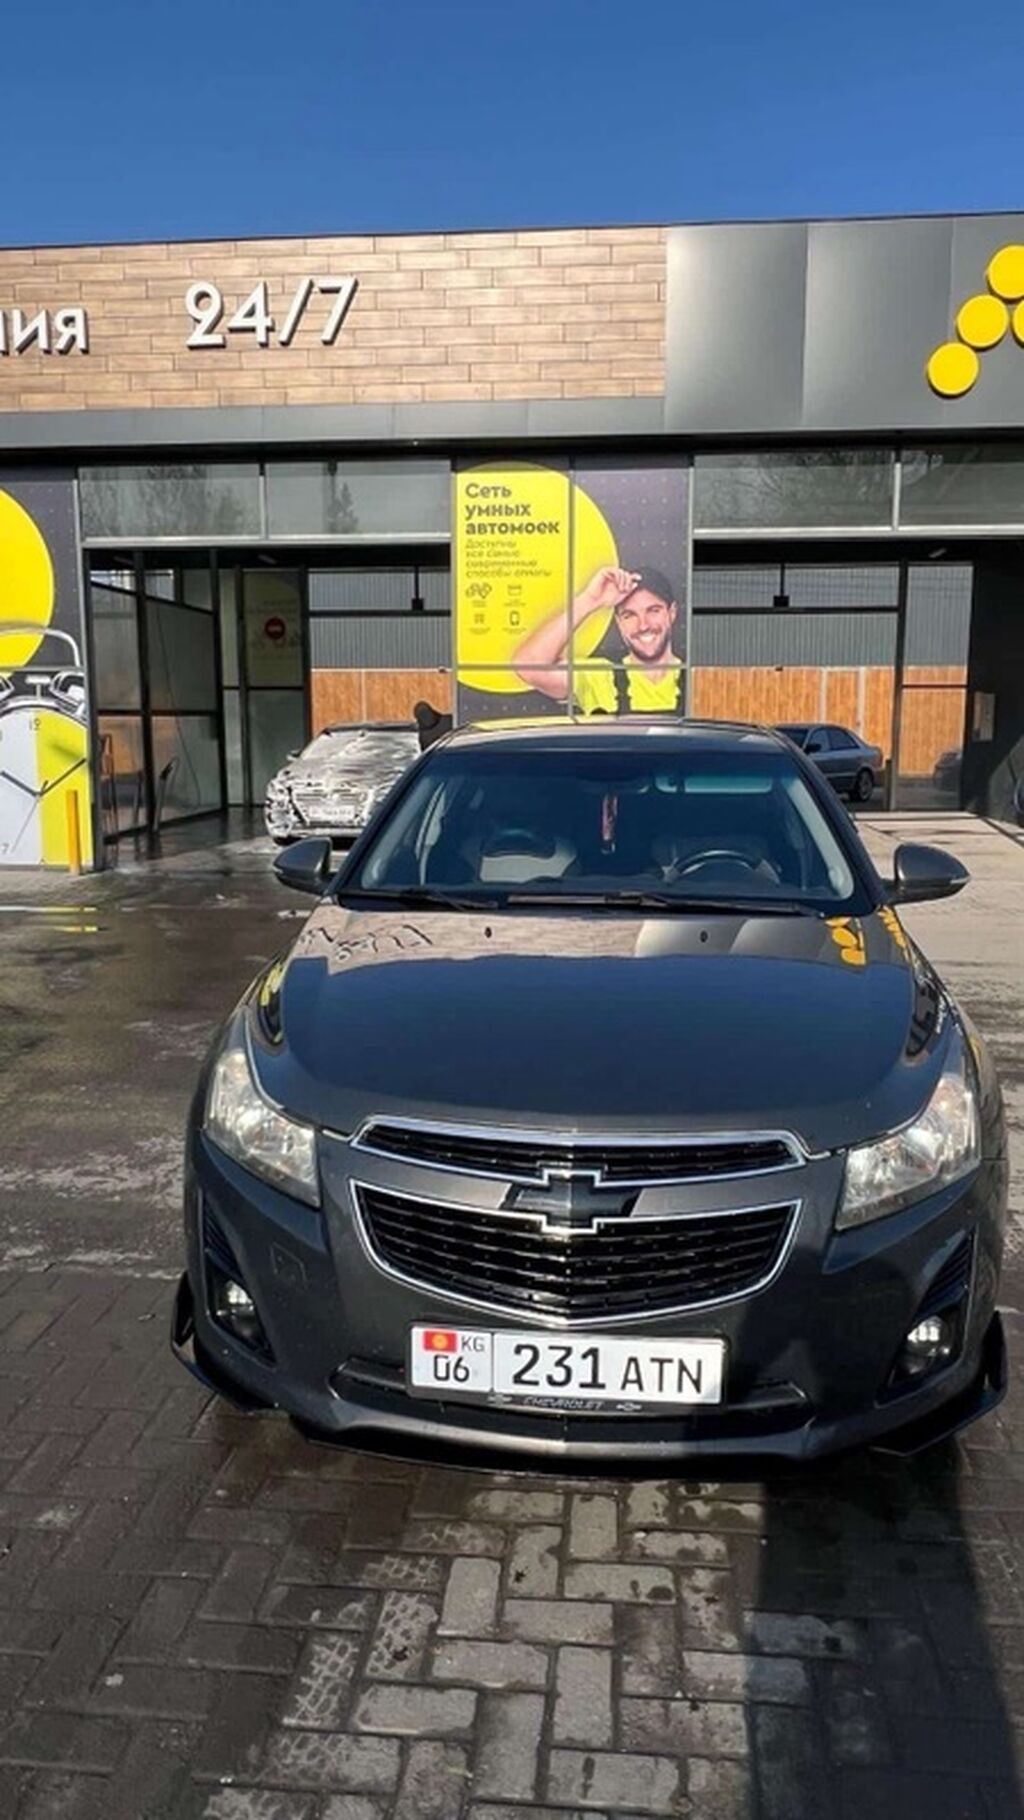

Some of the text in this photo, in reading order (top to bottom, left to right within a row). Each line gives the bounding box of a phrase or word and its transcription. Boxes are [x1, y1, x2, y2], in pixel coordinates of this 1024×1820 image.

[186, 275, 358, 349] 24/7
[465, 483, 512, 498] Сеть
[465, 504, 532, 521] умных
[465, 521, 560, 535] автомоек
[461, 1335, 486, 1352] KG
[433, 1344, 703, 1395] 06 231 ATN
[522, 1396, 606, 1411] CHEVROLET
